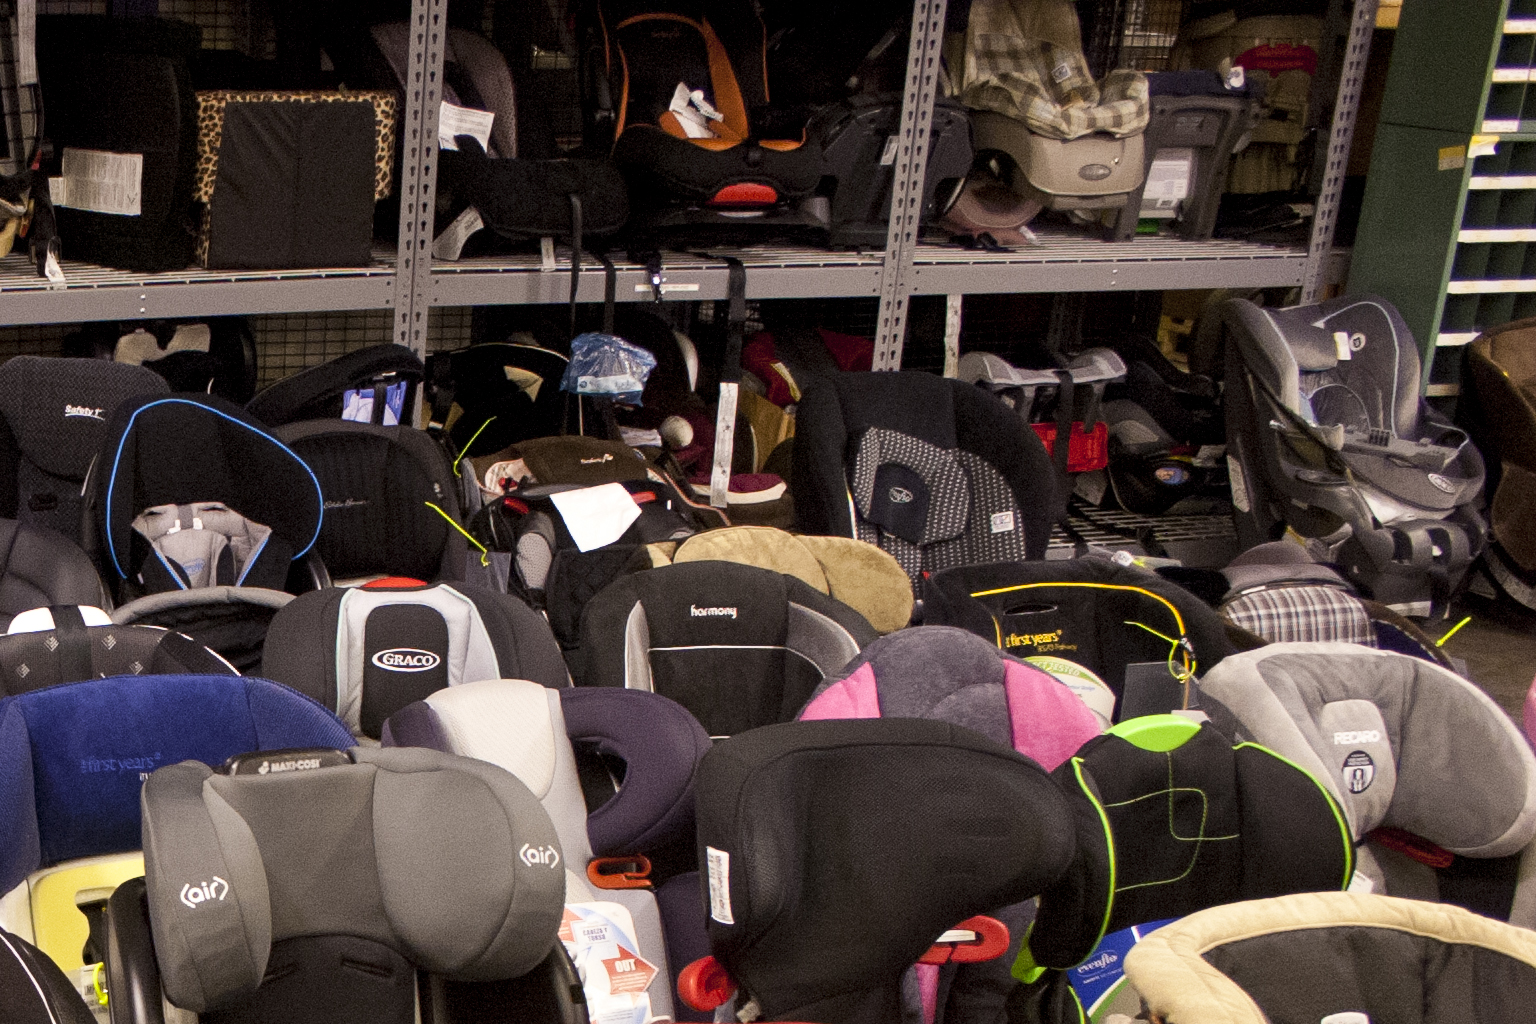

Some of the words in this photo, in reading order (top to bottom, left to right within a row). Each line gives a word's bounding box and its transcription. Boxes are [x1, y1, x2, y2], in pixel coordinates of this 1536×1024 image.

[65, 404, 93, 416] Safety
[690, 604, 737, 619] harmony
[382, 653, 434, 667] GRACO
[1333, 729, 1381, 746] RECARO
[270, 759, 321, 773] MAXI-COSI
[587, 934, 606, 942] TORSO
[614, 959, 636, 973] OUT
[1077, 953, 1118, 974] evenflo
